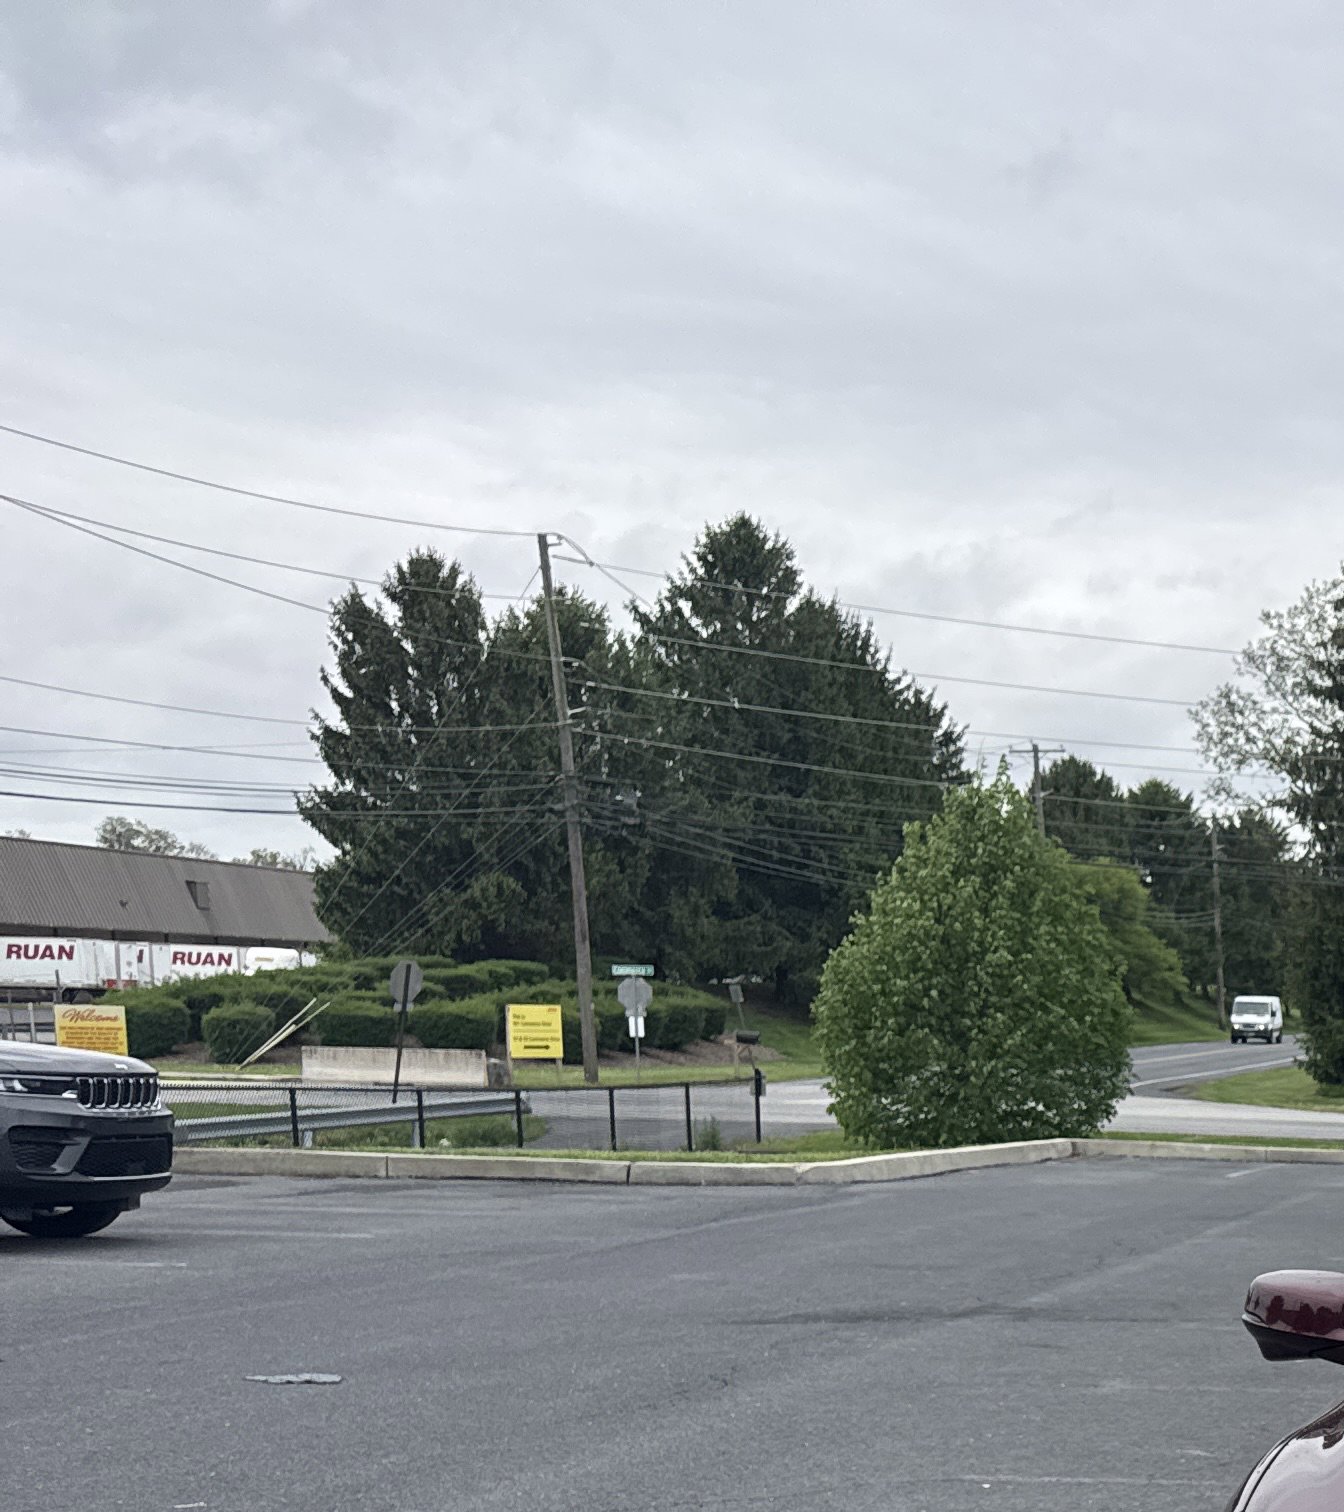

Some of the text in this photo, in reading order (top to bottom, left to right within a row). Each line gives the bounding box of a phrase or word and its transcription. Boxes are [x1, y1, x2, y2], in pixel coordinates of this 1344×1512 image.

[6, 944, 75, 960] RUAN
[172, 951, 232, 967] RUAN
[62, 1008, 118, 1023] Welcome
